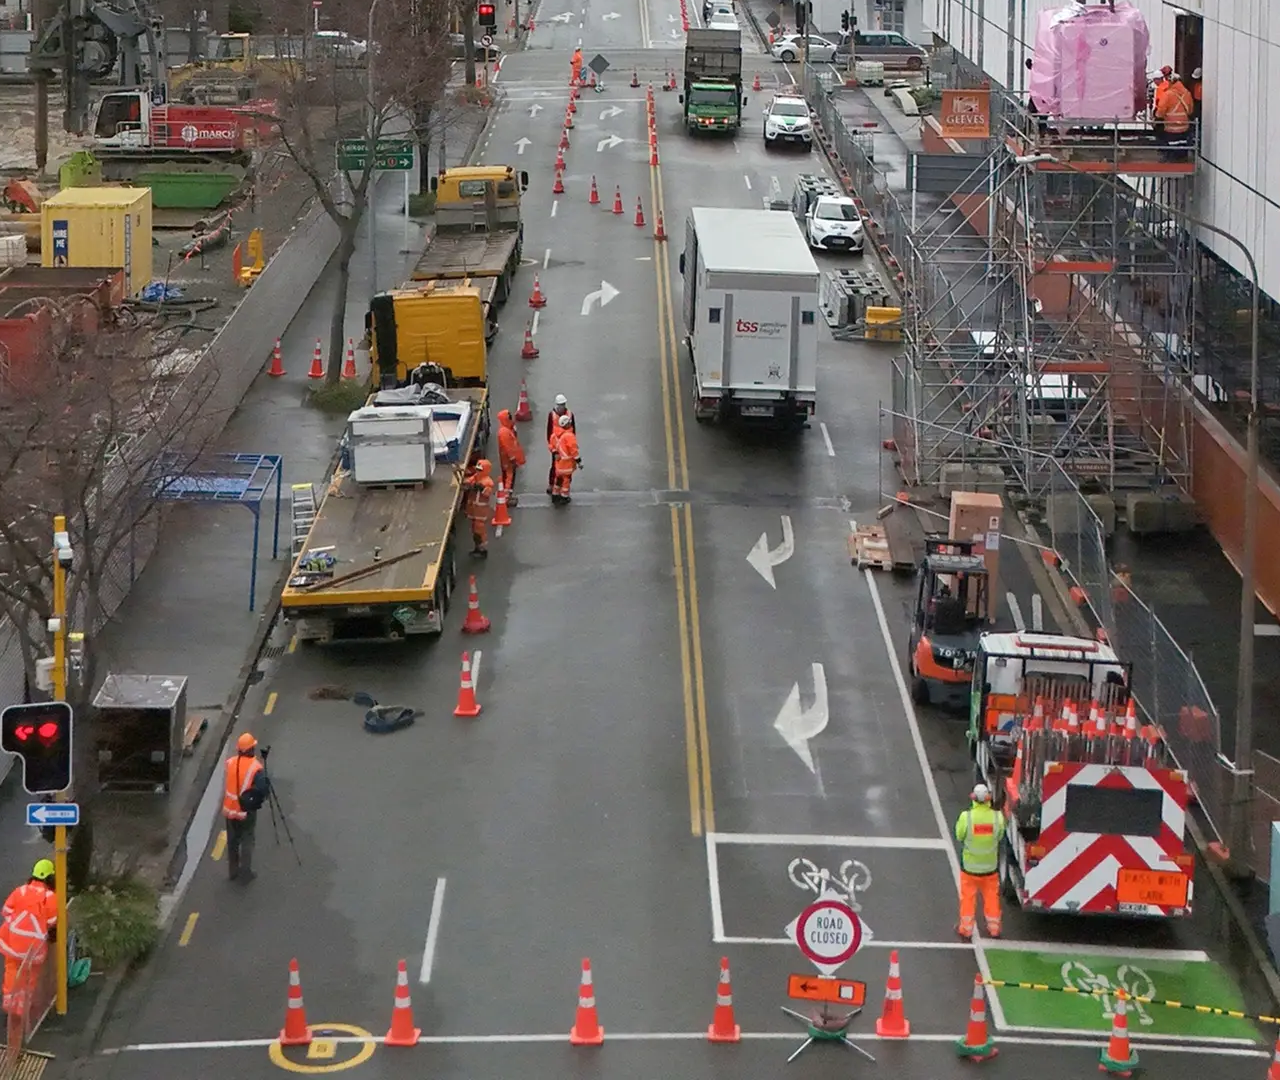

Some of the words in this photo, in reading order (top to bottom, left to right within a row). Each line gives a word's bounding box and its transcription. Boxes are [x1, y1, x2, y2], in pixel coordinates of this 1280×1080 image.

[736, 319, 759, 332] tss
[816, 917, 844, 930] ROAD
[810, 931, 849, 945] CLOSED
